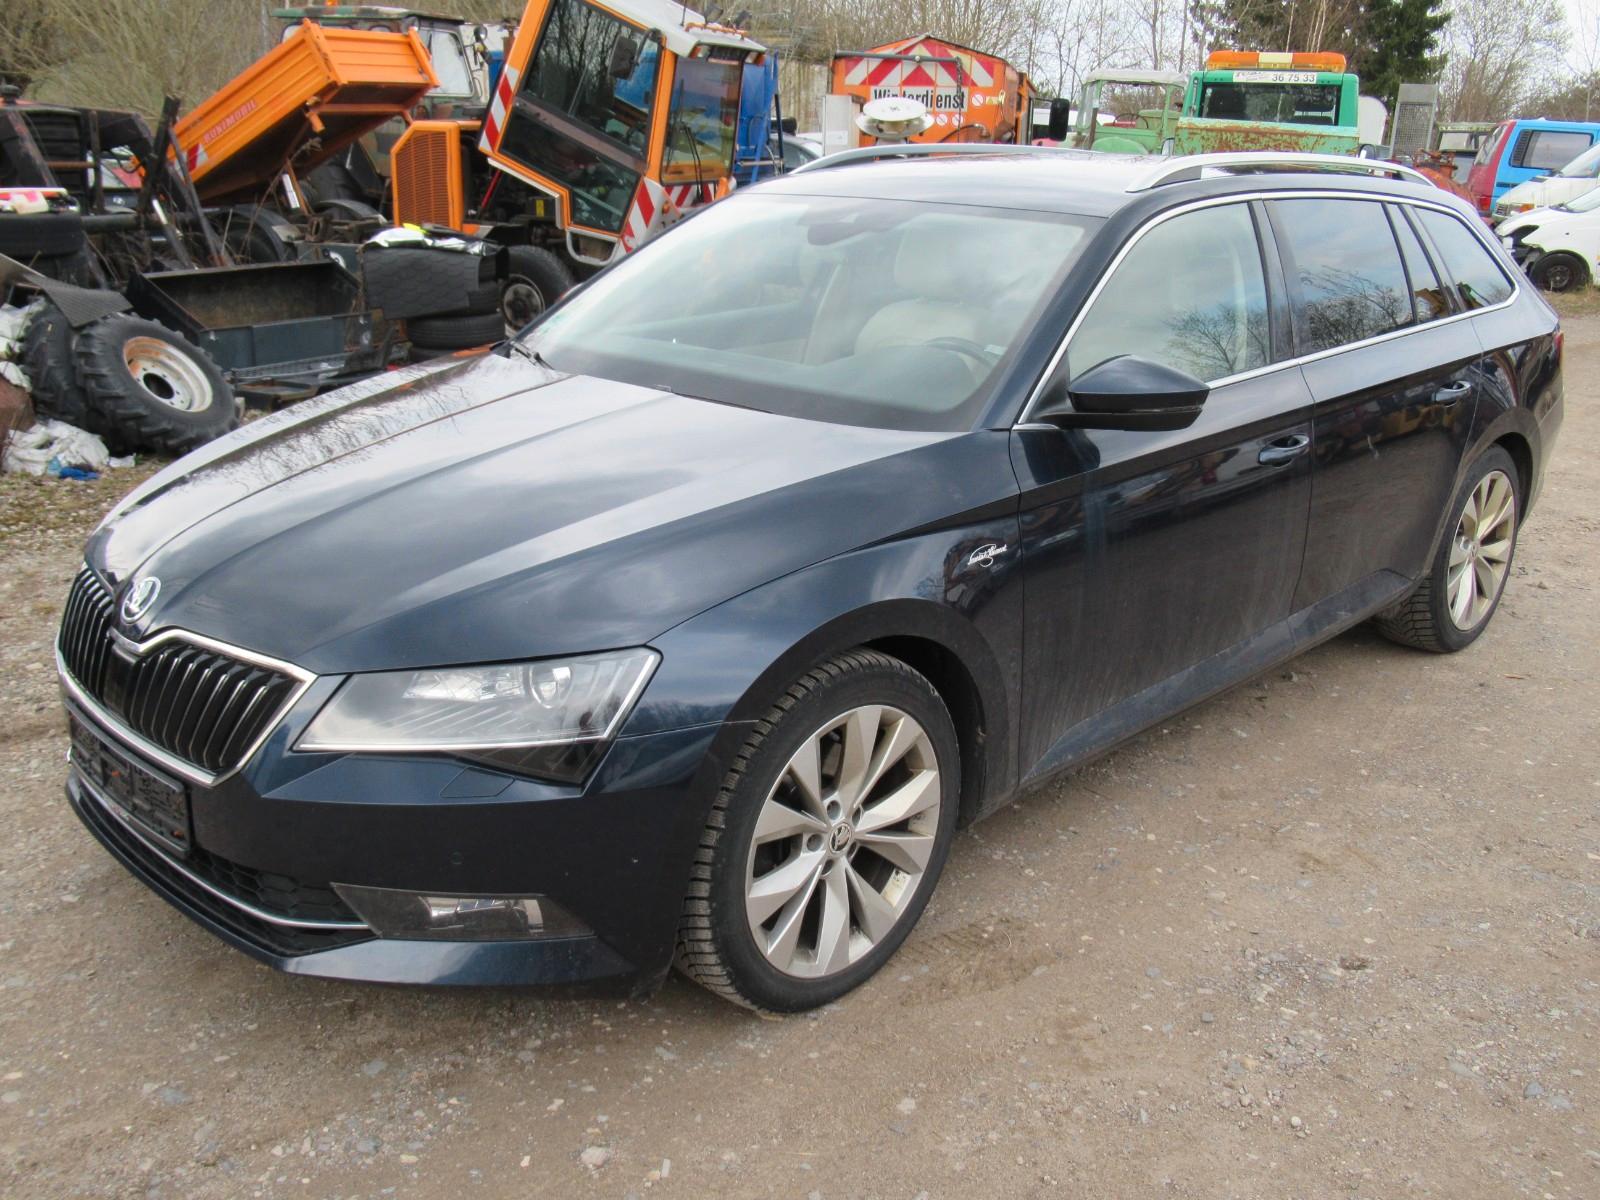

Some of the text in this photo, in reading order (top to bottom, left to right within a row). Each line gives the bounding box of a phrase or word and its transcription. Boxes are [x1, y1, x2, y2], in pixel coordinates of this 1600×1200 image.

[1272, 73, 1284, 82] 36
[1288, 73, 1300, 82] 75
[1303, 74, 1315, 82] 33
